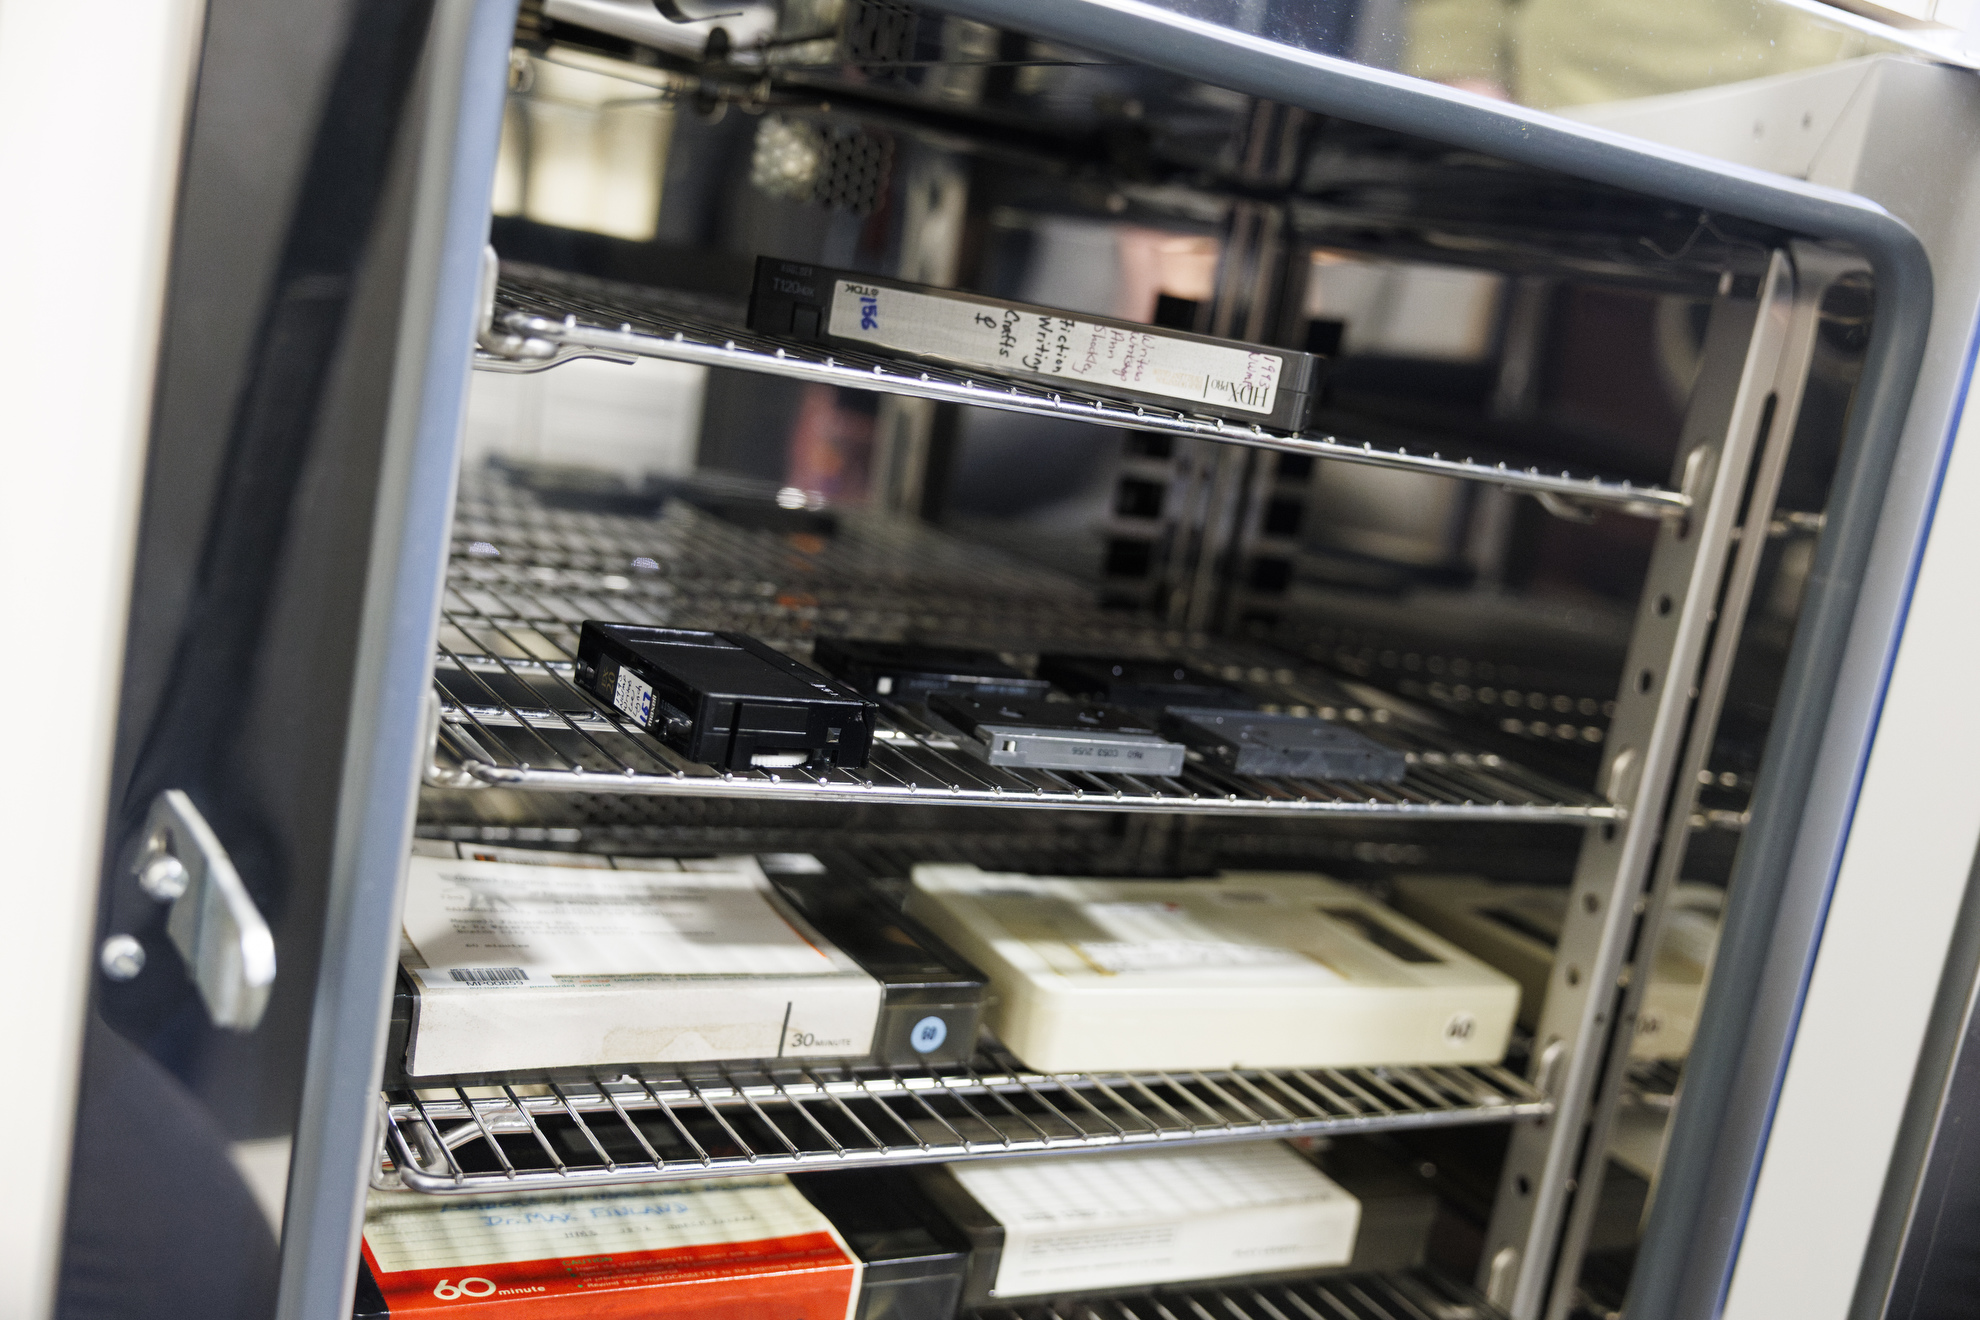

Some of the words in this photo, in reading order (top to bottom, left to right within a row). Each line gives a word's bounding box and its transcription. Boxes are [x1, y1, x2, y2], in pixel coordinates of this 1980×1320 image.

[845, 283, 871, 297] TDK
[859, 296, 878, 331] 156
[1022, 316, 1053, 372] Writing
[1107, 330, 1125, 359] Ann
[1211, 379, 1229, 391] PRO
[792, 1033, 815, 1047] 30
[815, 1038, 852, 1047] MINUTE
[562, 1256, 613, 1266] CAUTION
[433, 1277, 496, 1300] 60
[498, 1285, 546, 1297] minute
